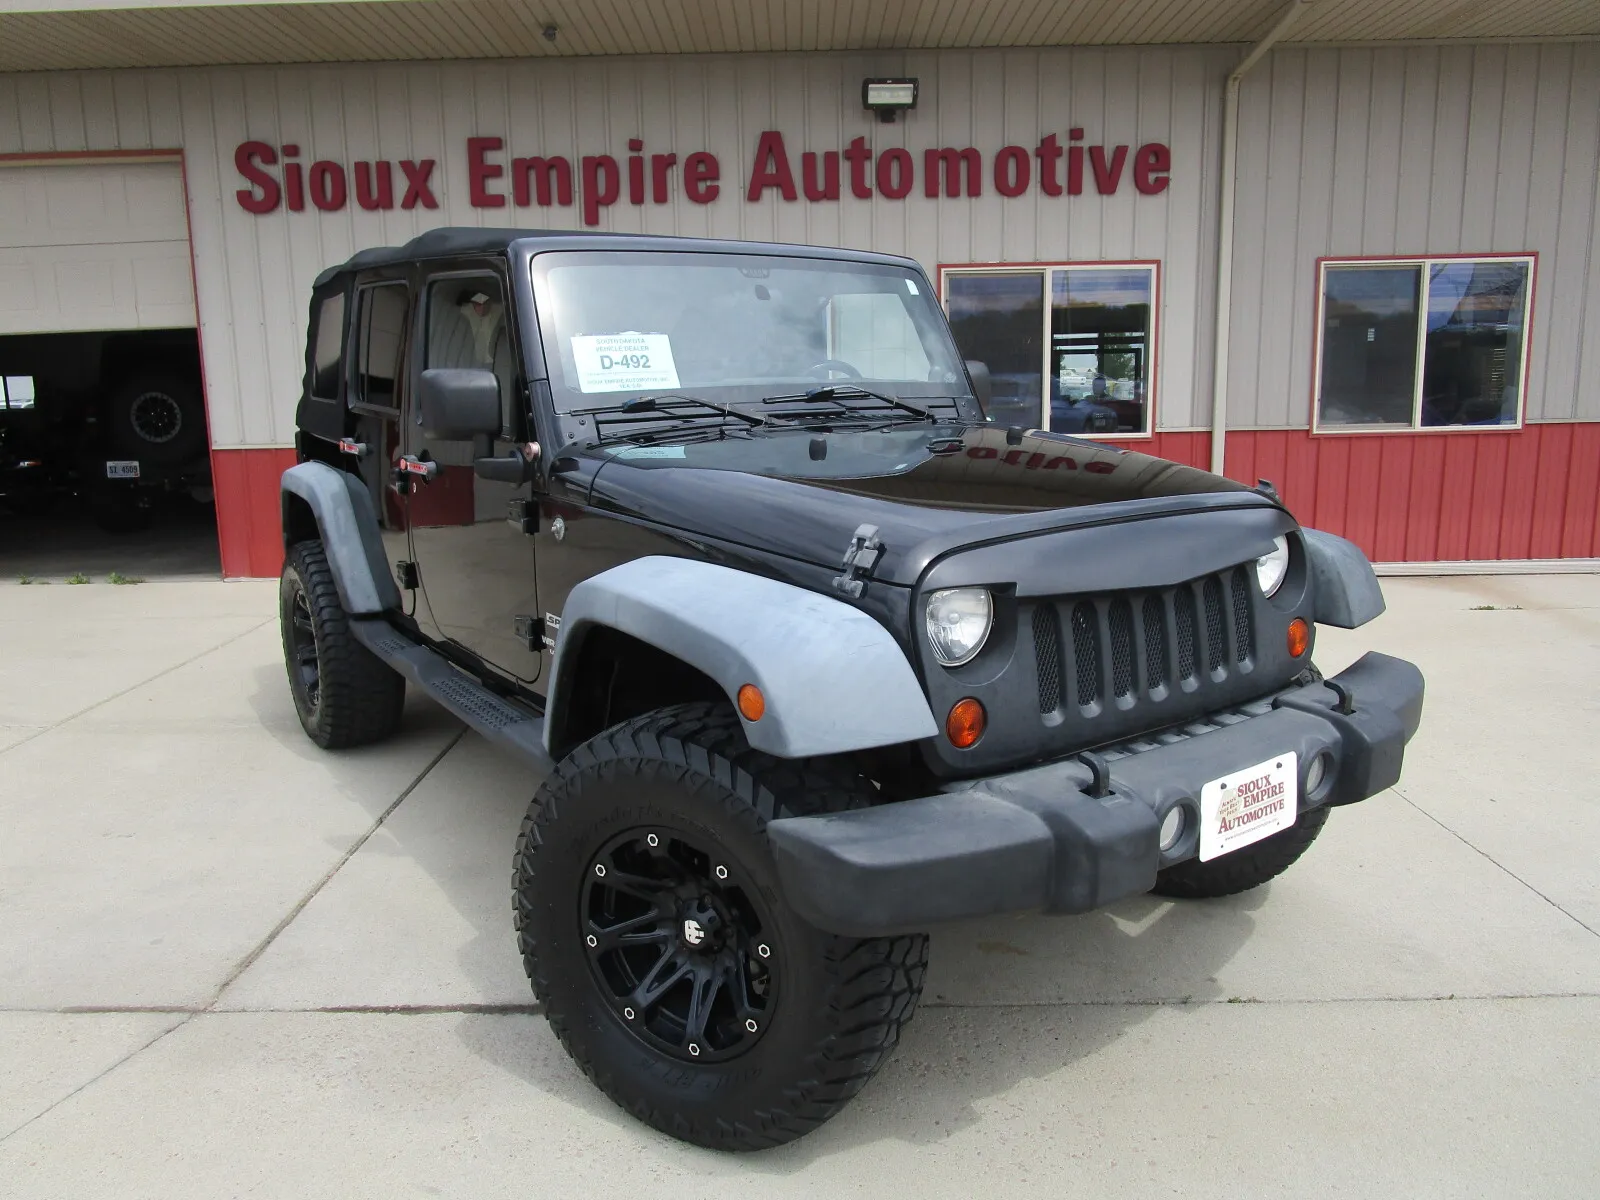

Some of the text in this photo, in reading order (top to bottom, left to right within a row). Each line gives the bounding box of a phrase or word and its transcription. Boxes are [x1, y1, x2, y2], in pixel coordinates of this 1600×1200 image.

[235, 127, 1171, 225] Sioux Empire Automotive
[596, 345, 622, 353] VEHICLE
[600, 354, 651, 369] D-492
[1237, 774, 1272, 798] SIOUX
[1243, 781, 1285, 809] EMPIRE
[1218, 798, 1285, 834] AUTOMOTIVE
